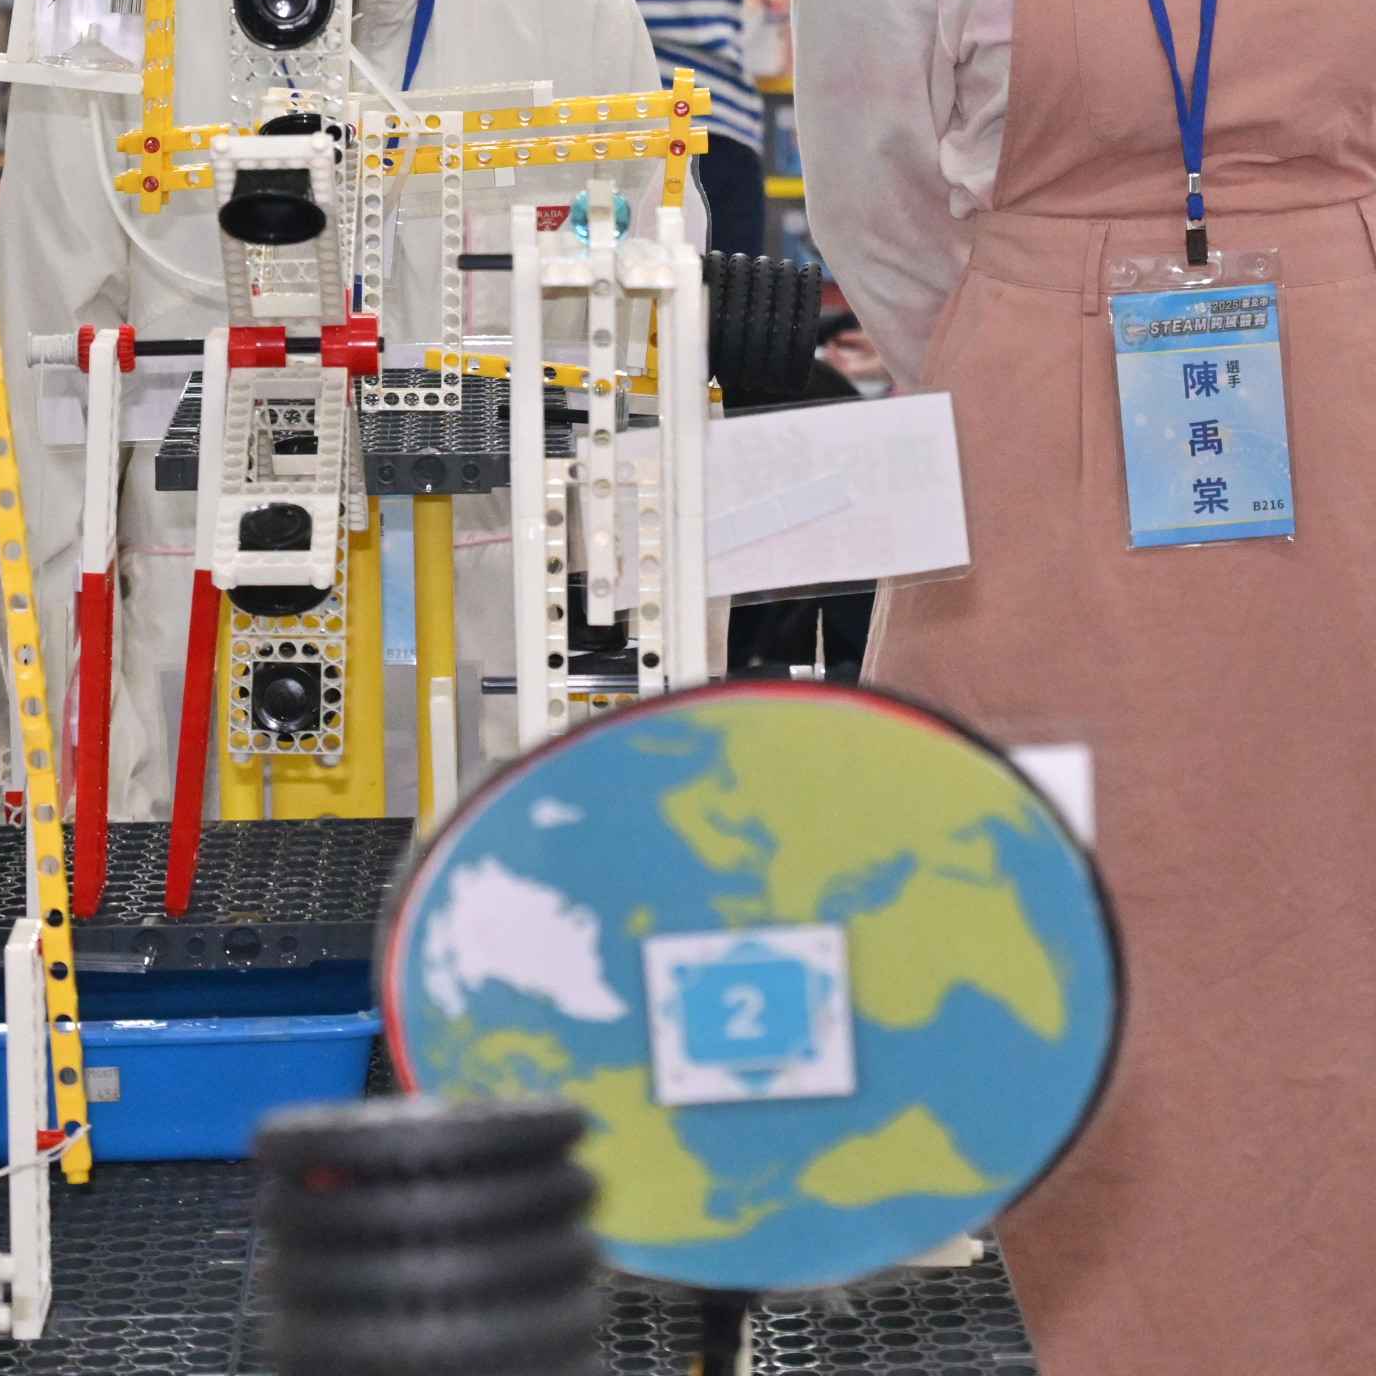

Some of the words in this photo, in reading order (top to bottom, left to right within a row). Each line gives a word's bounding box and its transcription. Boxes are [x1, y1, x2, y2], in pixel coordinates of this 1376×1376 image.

[1226, 360, 1240, 388] 選手
[1253, 499, 1285, 512] B216
[721, 985, 766, 1039] 2
